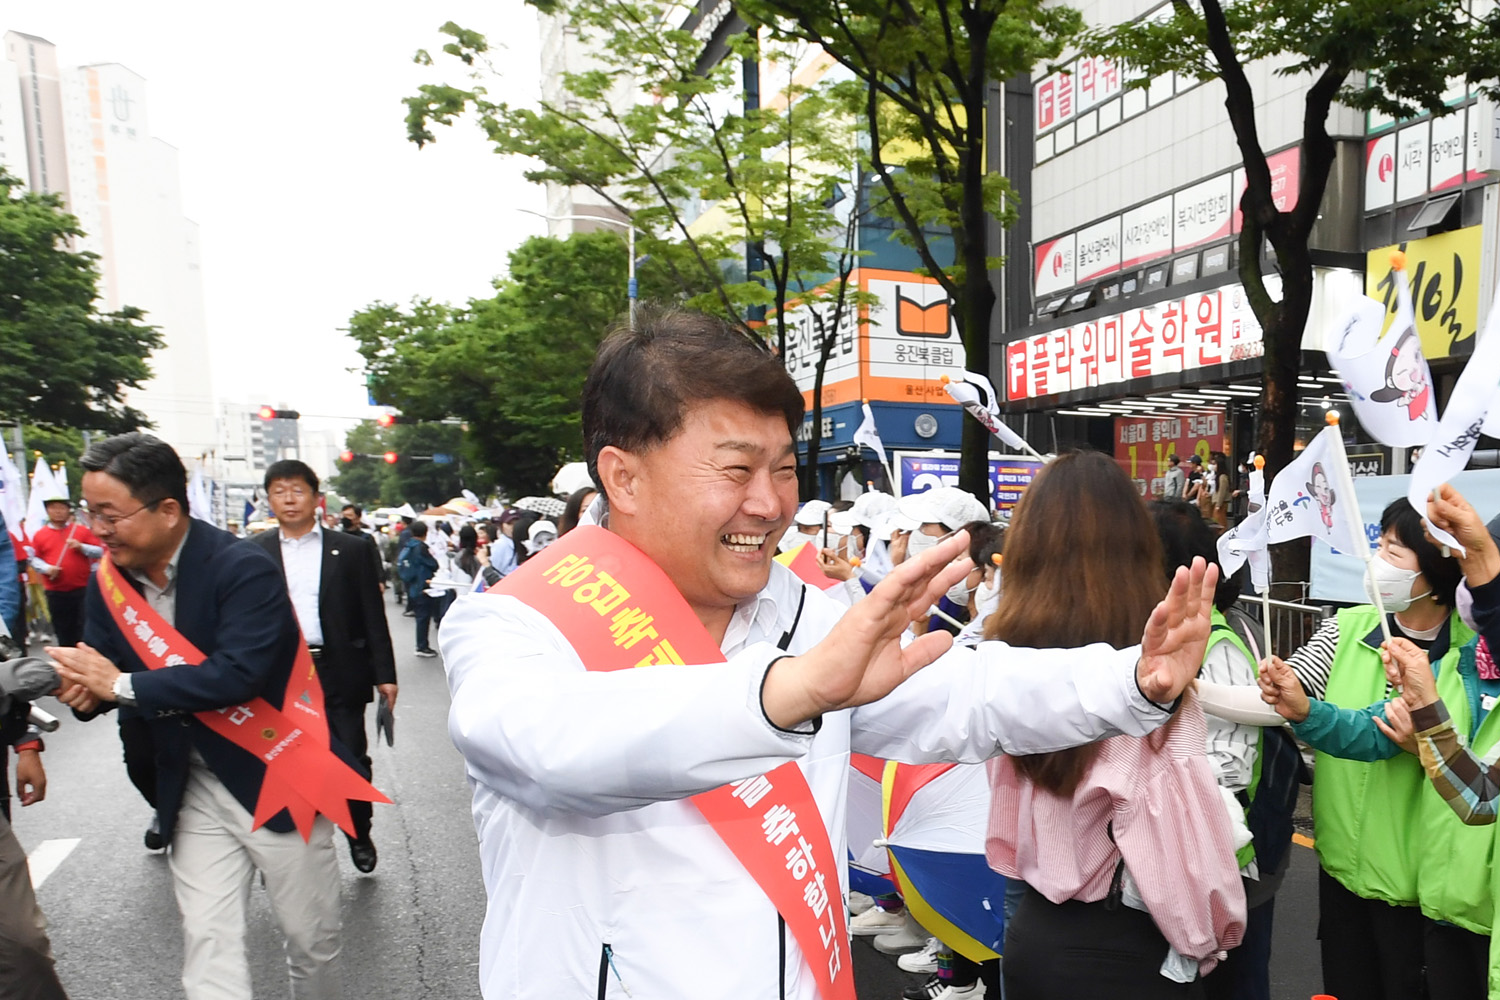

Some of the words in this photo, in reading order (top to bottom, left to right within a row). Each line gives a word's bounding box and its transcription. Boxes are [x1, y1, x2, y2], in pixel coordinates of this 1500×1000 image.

[1078, 232, 1119, 268] 울산광역시
[1124, 214, 1170, 247] 시각장애인
[1177, 193, 1228, 231] 복지연합회
[895, 343, 953, 365] 웅진북클럽
[1032, 290, 1222, 396] 플라워미술학원
[1120, 422, 1147, 443] 서울대
[1152, 419, 1182, 442] 홍익대
[1187, 414, 1218, 438] 건국대
[1128, 445, 1137, 479] 1
[761, 803, 842, 984] 축하합니다
